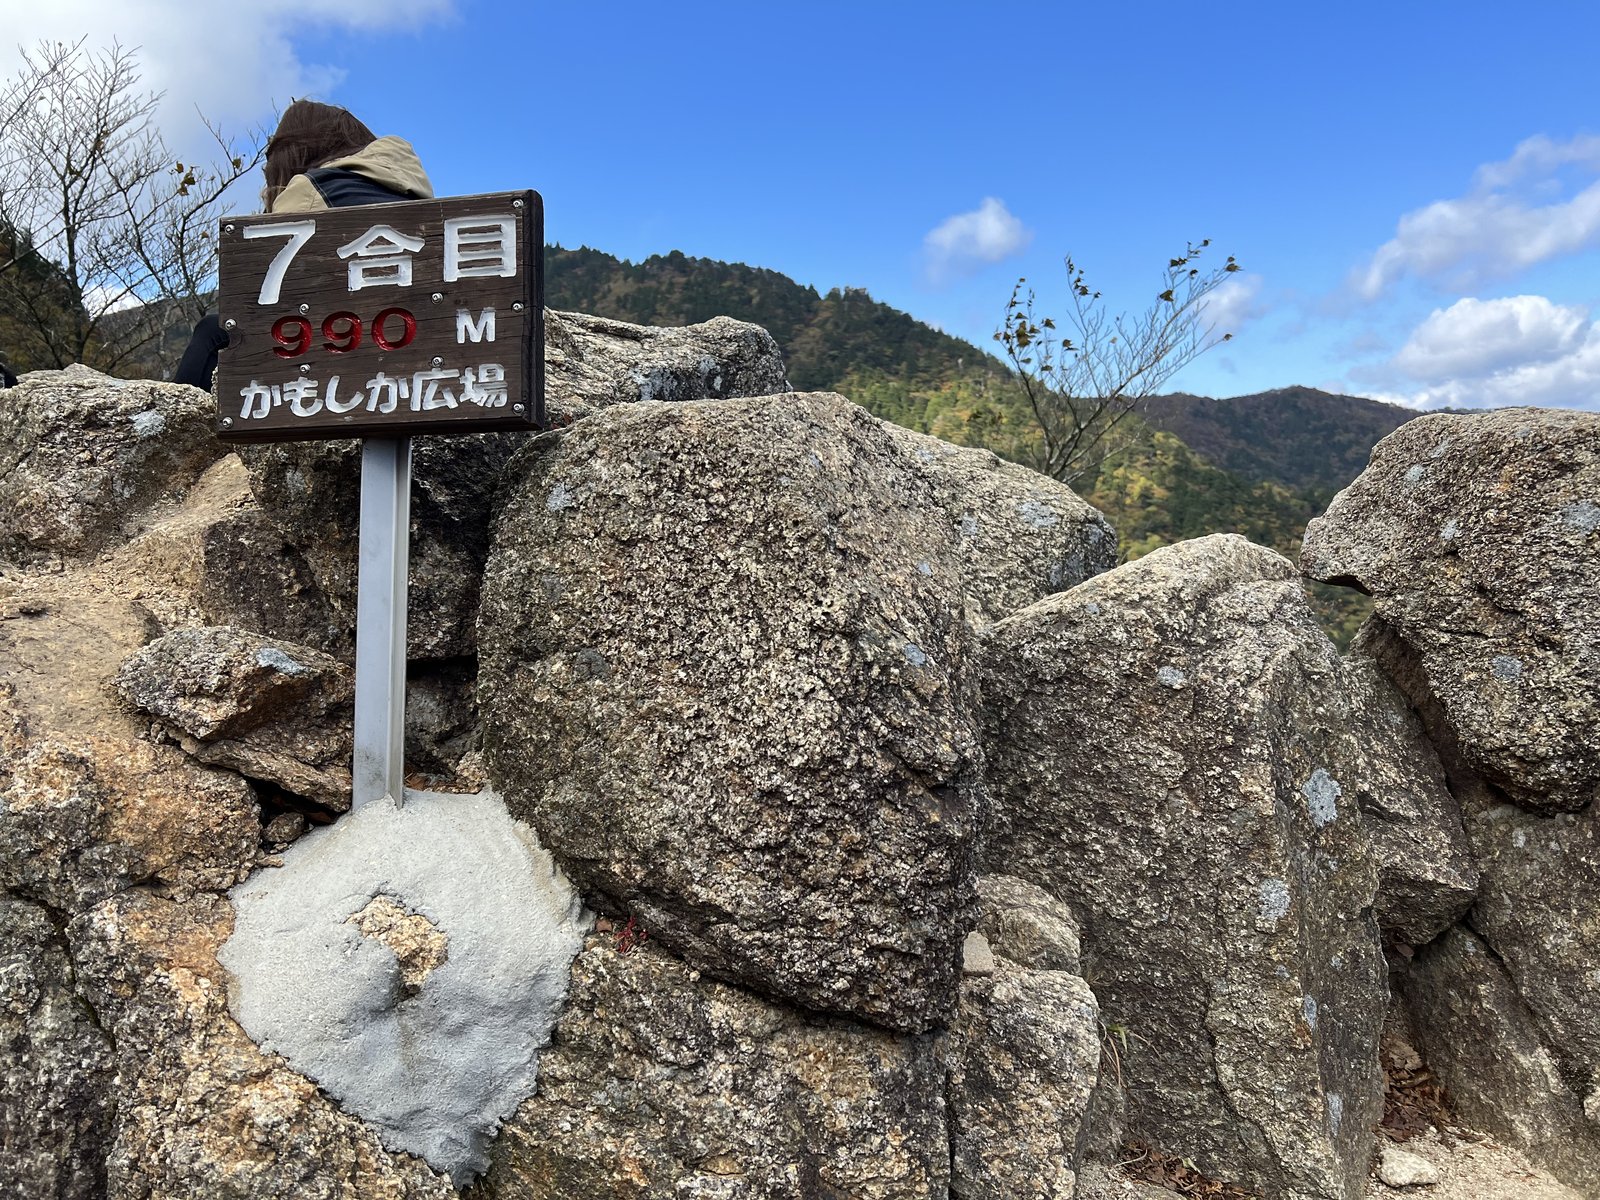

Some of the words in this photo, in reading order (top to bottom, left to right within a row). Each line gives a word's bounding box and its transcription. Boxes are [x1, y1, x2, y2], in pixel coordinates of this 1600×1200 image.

[243, 214, 517, 305] 7合目
[271, 307, 417, 359] 990
[456, 307, 496, 343] M
[240, 363, 508, 420] かもしか広場
